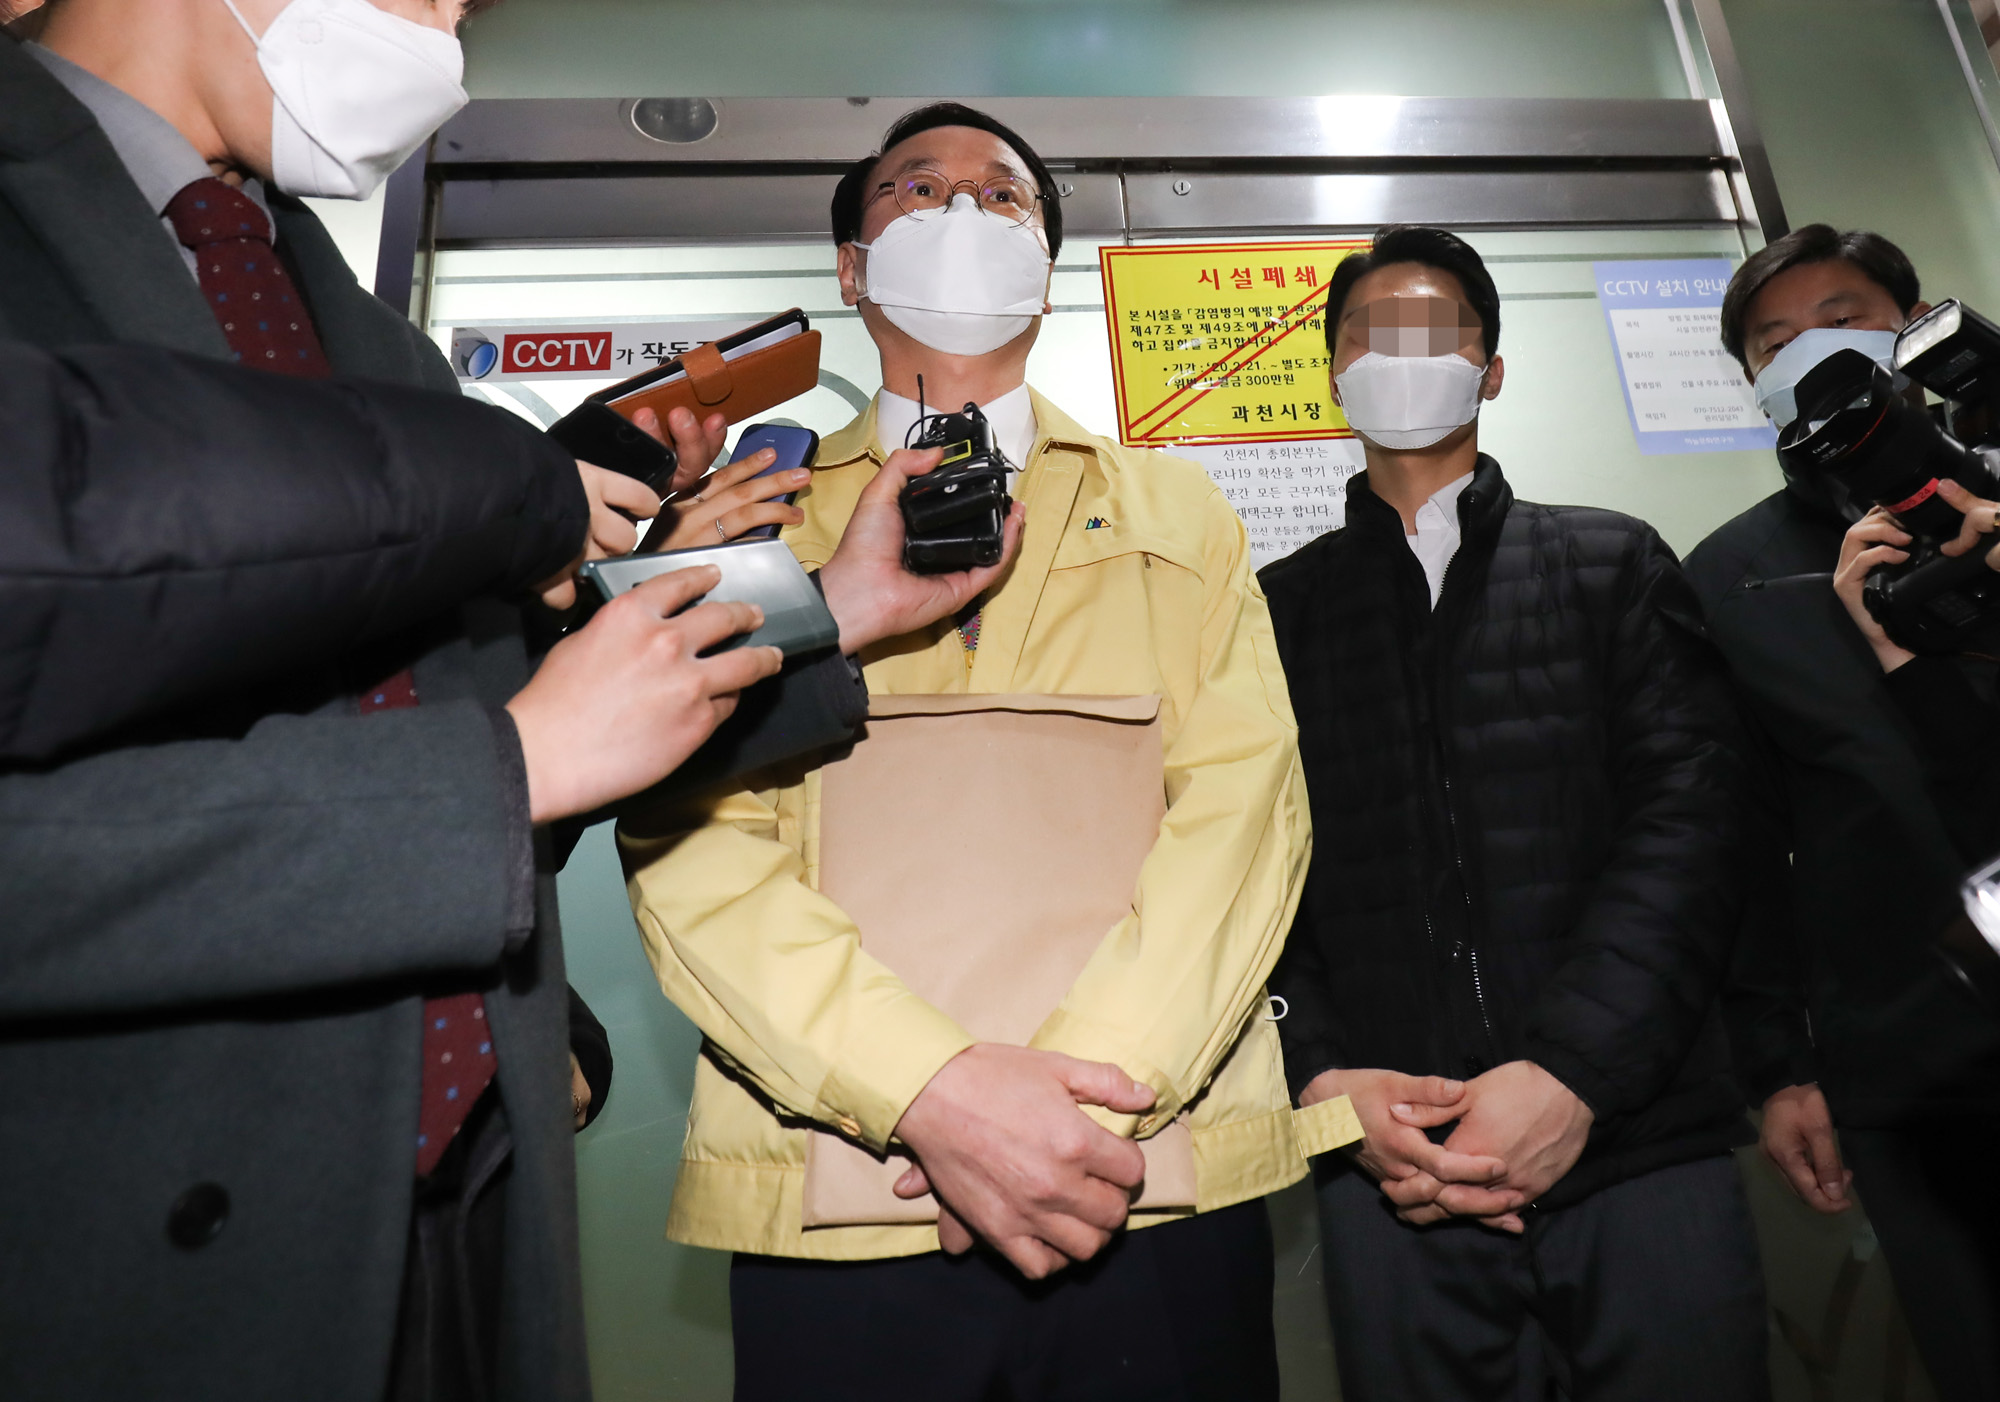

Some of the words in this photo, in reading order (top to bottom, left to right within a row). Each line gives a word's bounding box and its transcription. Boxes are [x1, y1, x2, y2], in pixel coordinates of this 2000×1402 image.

[1603, 280, 1649, 296] CCTV
[1655, 279, 1689, 297] 설치
[1694, 278, 1727, 296] 안내
[1129, 310, 1140, 321] 본
[1145, 309, 1182, 321] 시설을
[1248, 305, 1272, 317] 예방
[1130, 324, 1176, 336] 제47조
[1182, 323, 1193, 335] 및
[1199, 321, 1258, 334] 제49조에
[1264, 319, 1290, 331] 따라
[1294, 318, 1327, 331] 아래
[1132, 340, 1157, 352] 하고
[1207, 336, 1278, 350] 금지합니다.
[512, 339, 606, 367] CCTV
[616, 349, 634, 365] 가
[641, 341, 717, 365] 작동
[1172, 363, 1196, 375] 기간
[1281, 358, 1306, 370] 별도
[1246, 374, 1295, 386] 300만원
[1223, 448, 1260, 461] 신천지
[1267, 447, 1328, 461] 총회본부는
[1206, 468, 1251, 480] 로나19
[1258, 467, 1295, 480] 확산을
[1301, 465, 1325, 478] 막기
[1333, 464, 1356, 477] 위해
[1222, 487, 1249, 500] 분간
[1257, 487, 1281, 499] 모든
[1235, 506, 1285, 520] 재택근무
[1292, 504, 1334, 518] 합니다.
[1246, 526, 1268, 537] 으신
[1274, 526, 1301, 536] 분들은
[1279, 541, 1289, 551] 문
